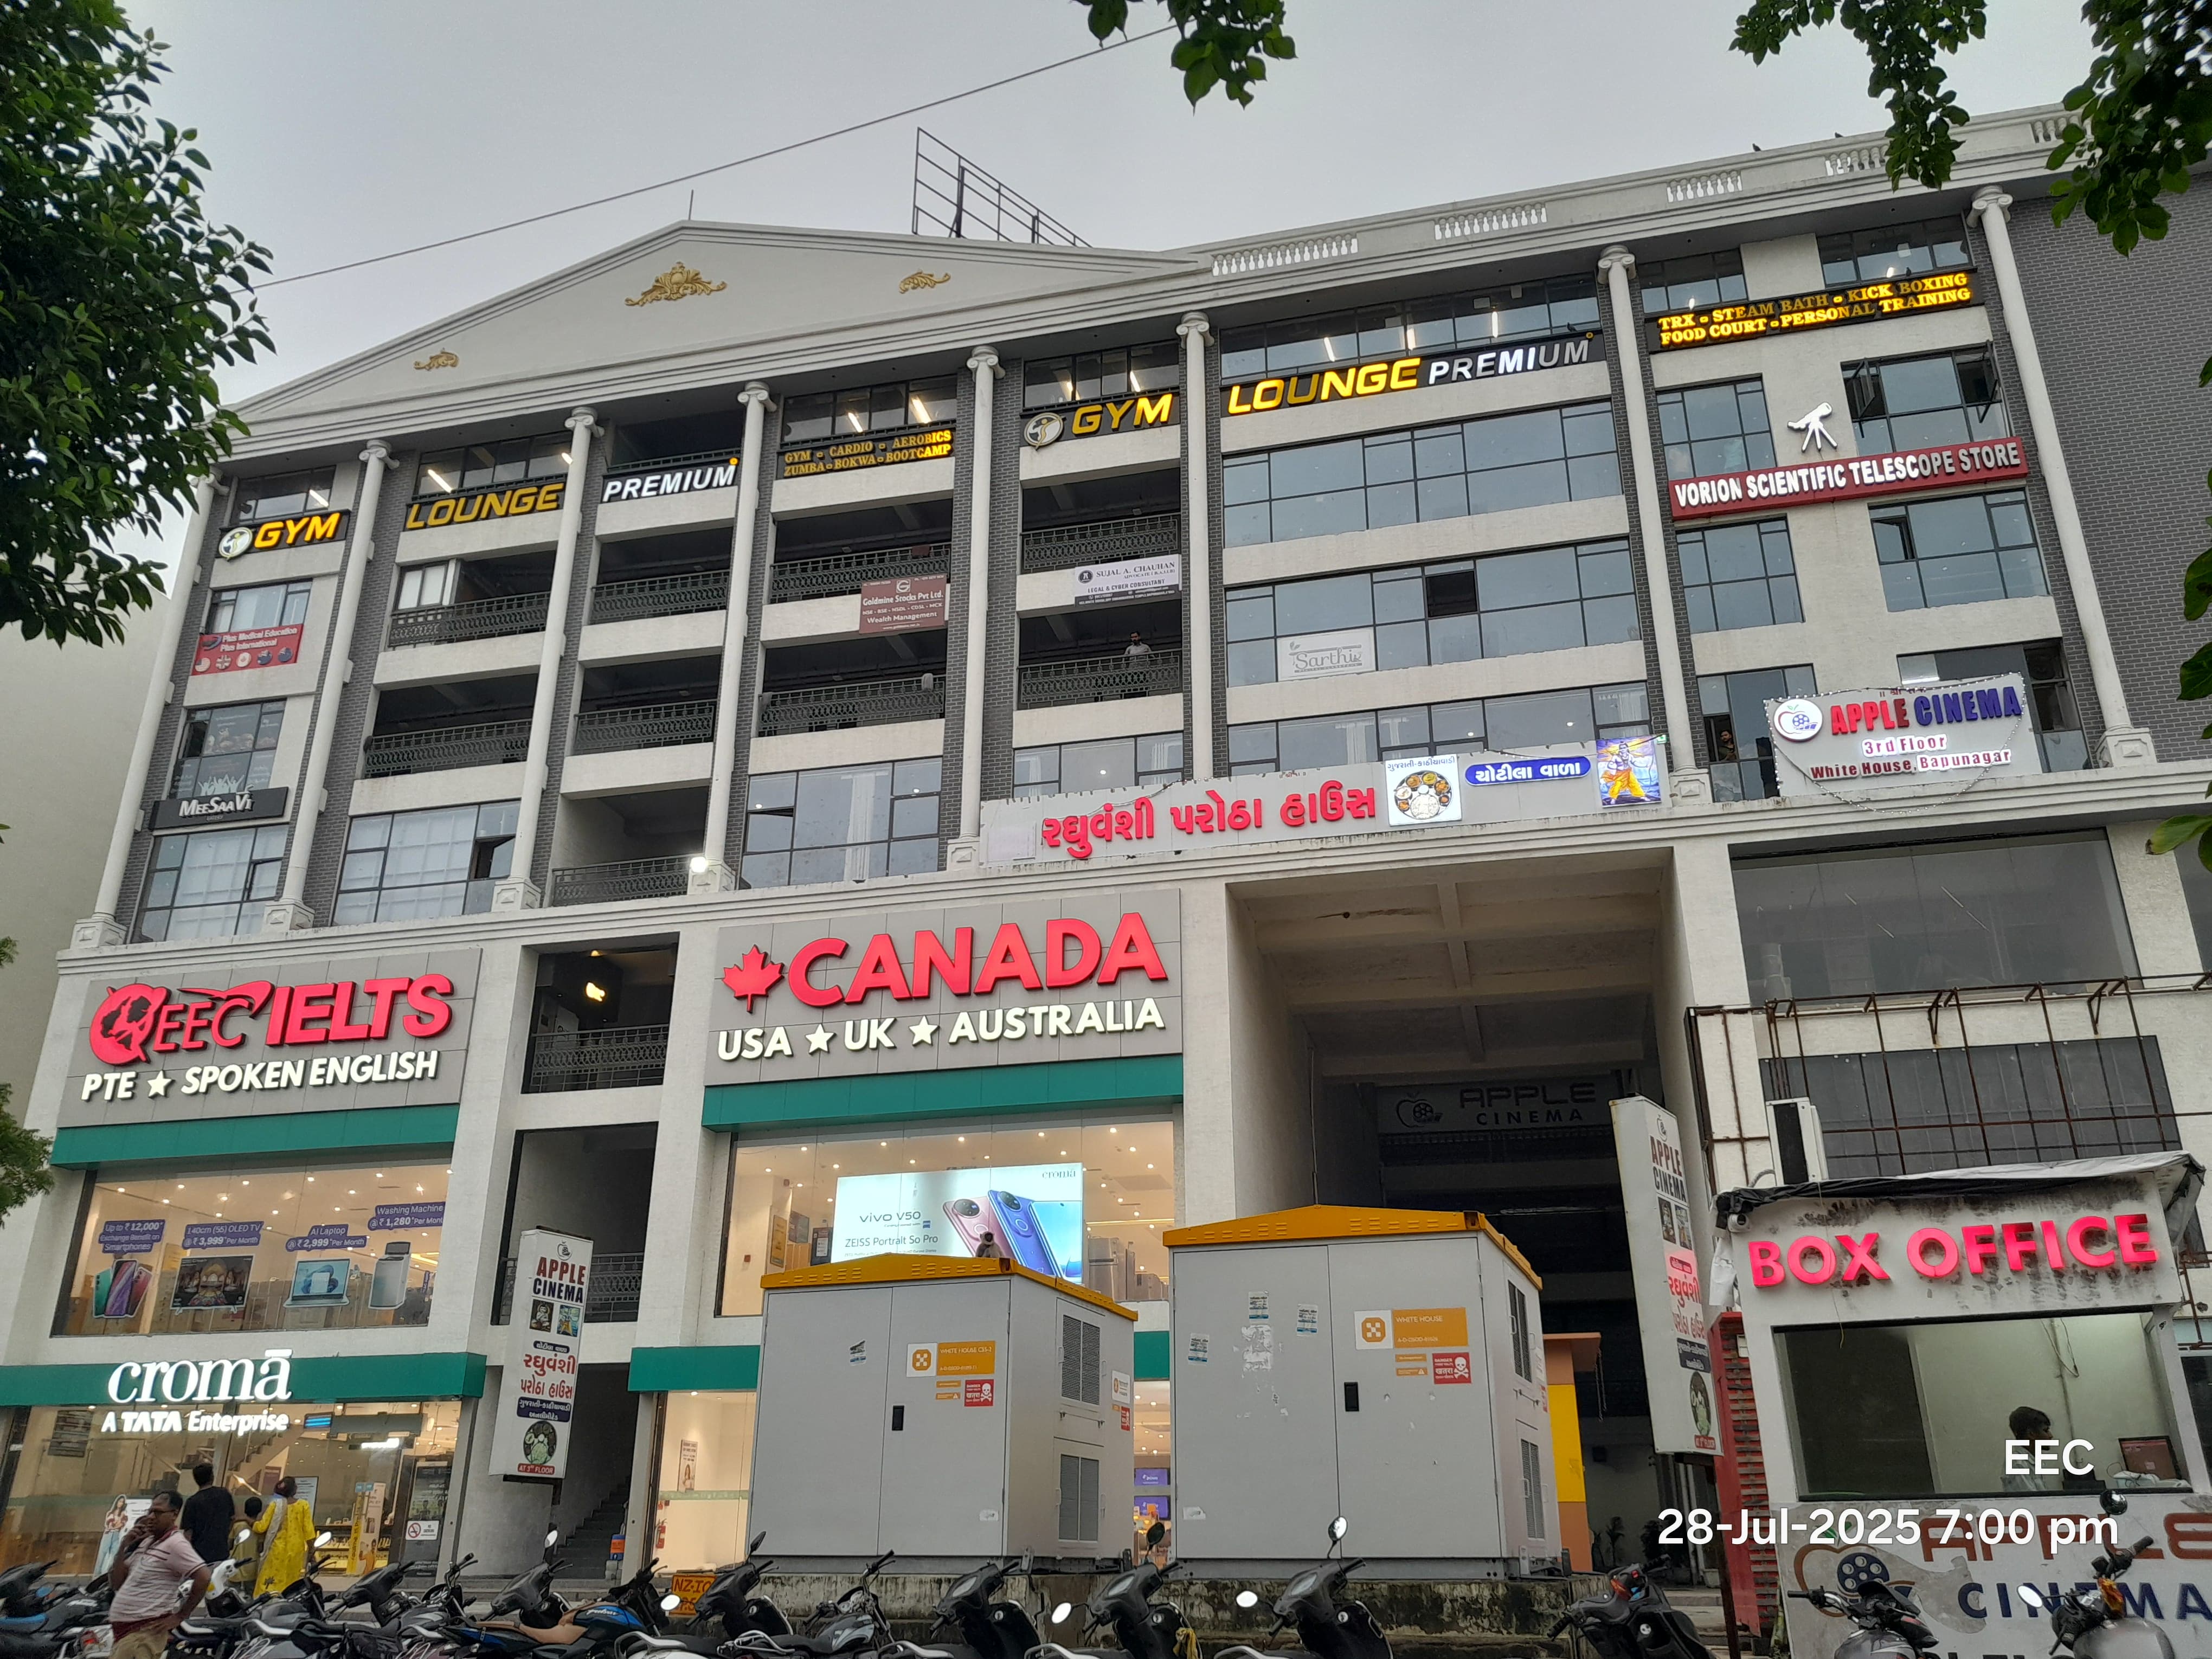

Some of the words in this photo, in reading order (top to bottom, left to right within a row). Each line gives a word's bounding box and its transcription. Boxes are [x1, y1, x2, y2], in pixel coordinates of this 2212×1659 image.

[1658, 315, 1696, 329] TRX
[1712, 301, 1774, 321] STEAM
[1780, 294, 1829, 311] BATH
[1847, 284, 1893, 301] KICK
[1899, 273, 1967, 293] BOXING
[1661, 328, 1706, 345] FOOD
[1709, 319, 1767, 337] COURT
[1781, 303, 1875, 328] PERSONAL
[1879, 288, 1972, 313] TRAINING
[1072, 393, 1173, 434] GYM
[1227, 357, 1420, 414] LOUNGE
[1428, 338, 1589, 384] PREMIUM
[785, 450, 812, 464] GYM
[829, 440, 873, 457] CARDIO
[892, 430, 951, 448] AEROBICS
[785, 461, 825, 477] ZUMBA
[834, 454, 876, 470] BOKWA
[886, 445, 951, 463] BOOTCAMP
[1674, 478, 1744, 507] VORION
[1747, 465, 1846, 500] SCIENTIFIC
[1848, 452, 1957, 486] TELESCOPE
[1959, 441, 2022, 471] STORE
[254, 512, 342, 549] GYM
[406, 483, 565, 529] LOUNGE
[602, 464, 737, 502] PREMIUM
[1096, 569, 1121, 577] SUJAL
[1134, 561, 1175, 573] CHAUHAN
[863, 597, 893, 606] Goldmine
[895, 594, 916, 603] Stocks
[931, 590, 944, 598] Ltd.
[1088, 585, 1104, 593] LEGAL
[1111, 582, 1128, 590] CYBER
[1130, 578, 1166, 588] CONSULTANT
[867, 615, 892, 623] Wealth
[893, 612, 937, 621] Management
[264, 627, 297, 638] Education
[1830, 699, 1909, 735] APPLE
[1914, 687, 2022, 726] CINEMA
[1864, 739, 1895, 754] 3rd
[1901, 735, 1946, 751] Floor
[1475, 763, 1531, 782] ચોટીલા
[1540, 761, 1580, 776] વાળા
[1811, 763, 1857, 779] White
[1862, 760, 1916, 774] House,
[1920, 750, 2010, 768] Bapunagar
[1042, 796, 1153, 859] રઘુવંશી
[1171, 789, 1261, 833] પરોઠા
[1280, 780, 1375, 827] હાઉસ
[789, 912, 1167, 1007] CANADA
[154, 996, 252, 1053] EEC
[266, 974, 453, 1046] IELTS
[717, 1027, 793, 1060] USA
[844, 1018, 896, 1049] UK
[948, 997, 1165, 1044] AUSTRALIA
[81, 1072, 136, 1101] PTE
[181, 1059, 305, 1095] SPOKEN
[309, 1050, 439, 1086] ENGLISH
[1460, 1084, 1597, 1108] APPLE
[1476, 1109, 1584, 1126] CINEMA
[1650, 1135, 1682, 1178] APPLE
[1653, 1166, 1687, 1203] CINEMA
[377, 1207, 410, 1216] Washing
[410, 1205, 443, 1213] Machine
[859, 1212, 892, 1223] vivo
[897, 1211, 921, 1220] V50
[320, 1227, 346, 1237] Laptop
[845, 1238, 870, 1248] ZEISS
[909, 1235, 921, 1244] So
[923, 1234, 938, 1243] Pro
[105, 1244, 151, 1252] Smartphones
[1748, 1232, 1890, 1287] BOX
[1906, 1214, 2157, 1278] OFFICE
[536, 1256, 586, 1285] APPLE
[533, 1278, 583, 1303] CINEMA
[523, 1353, 576, 1376] રઘુવંશી
[520, 1374, 545, 1396] પરોઠા
[548, 1380, 573, 1399] હાઉસ
[101, 1412, 116, 1432] A
[121, 1411, 182, 1432] TATA
[188, 1411, 289, 1436] Enterprise
